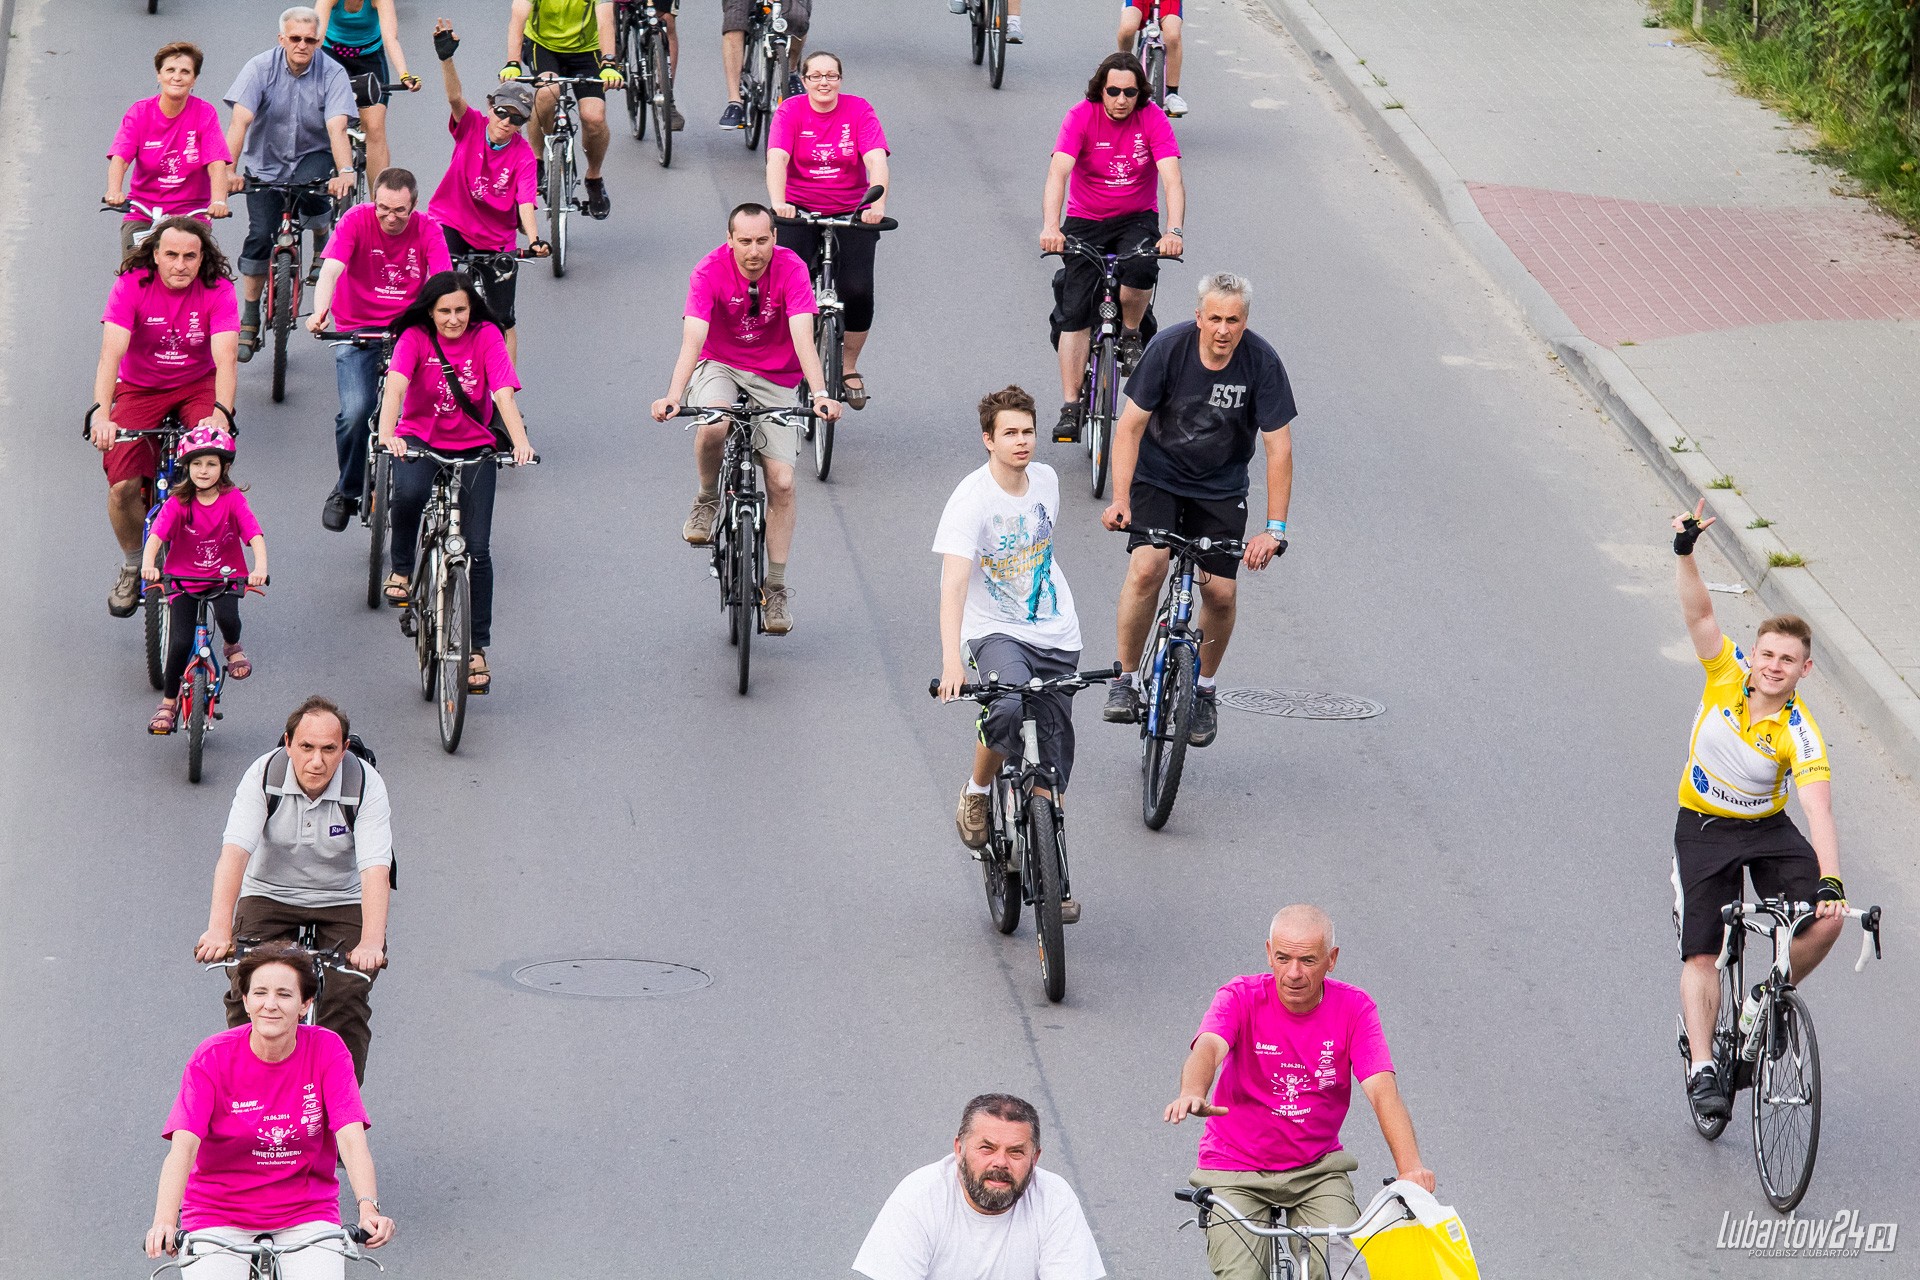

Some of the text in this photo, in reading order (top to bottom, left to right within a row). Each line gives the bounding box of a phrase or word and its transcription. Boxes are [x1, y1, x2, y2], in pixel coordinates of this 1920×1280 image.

[1797, 726, 1814, 759] Skandia
[1711, 785, 1769, 808] Skandia
[1287, 1107, 1311, 1116] ROWERU
[262, 1113, 290, 1122] 29.06.2014
[275, 1149, 302, 1158] ROWERU
